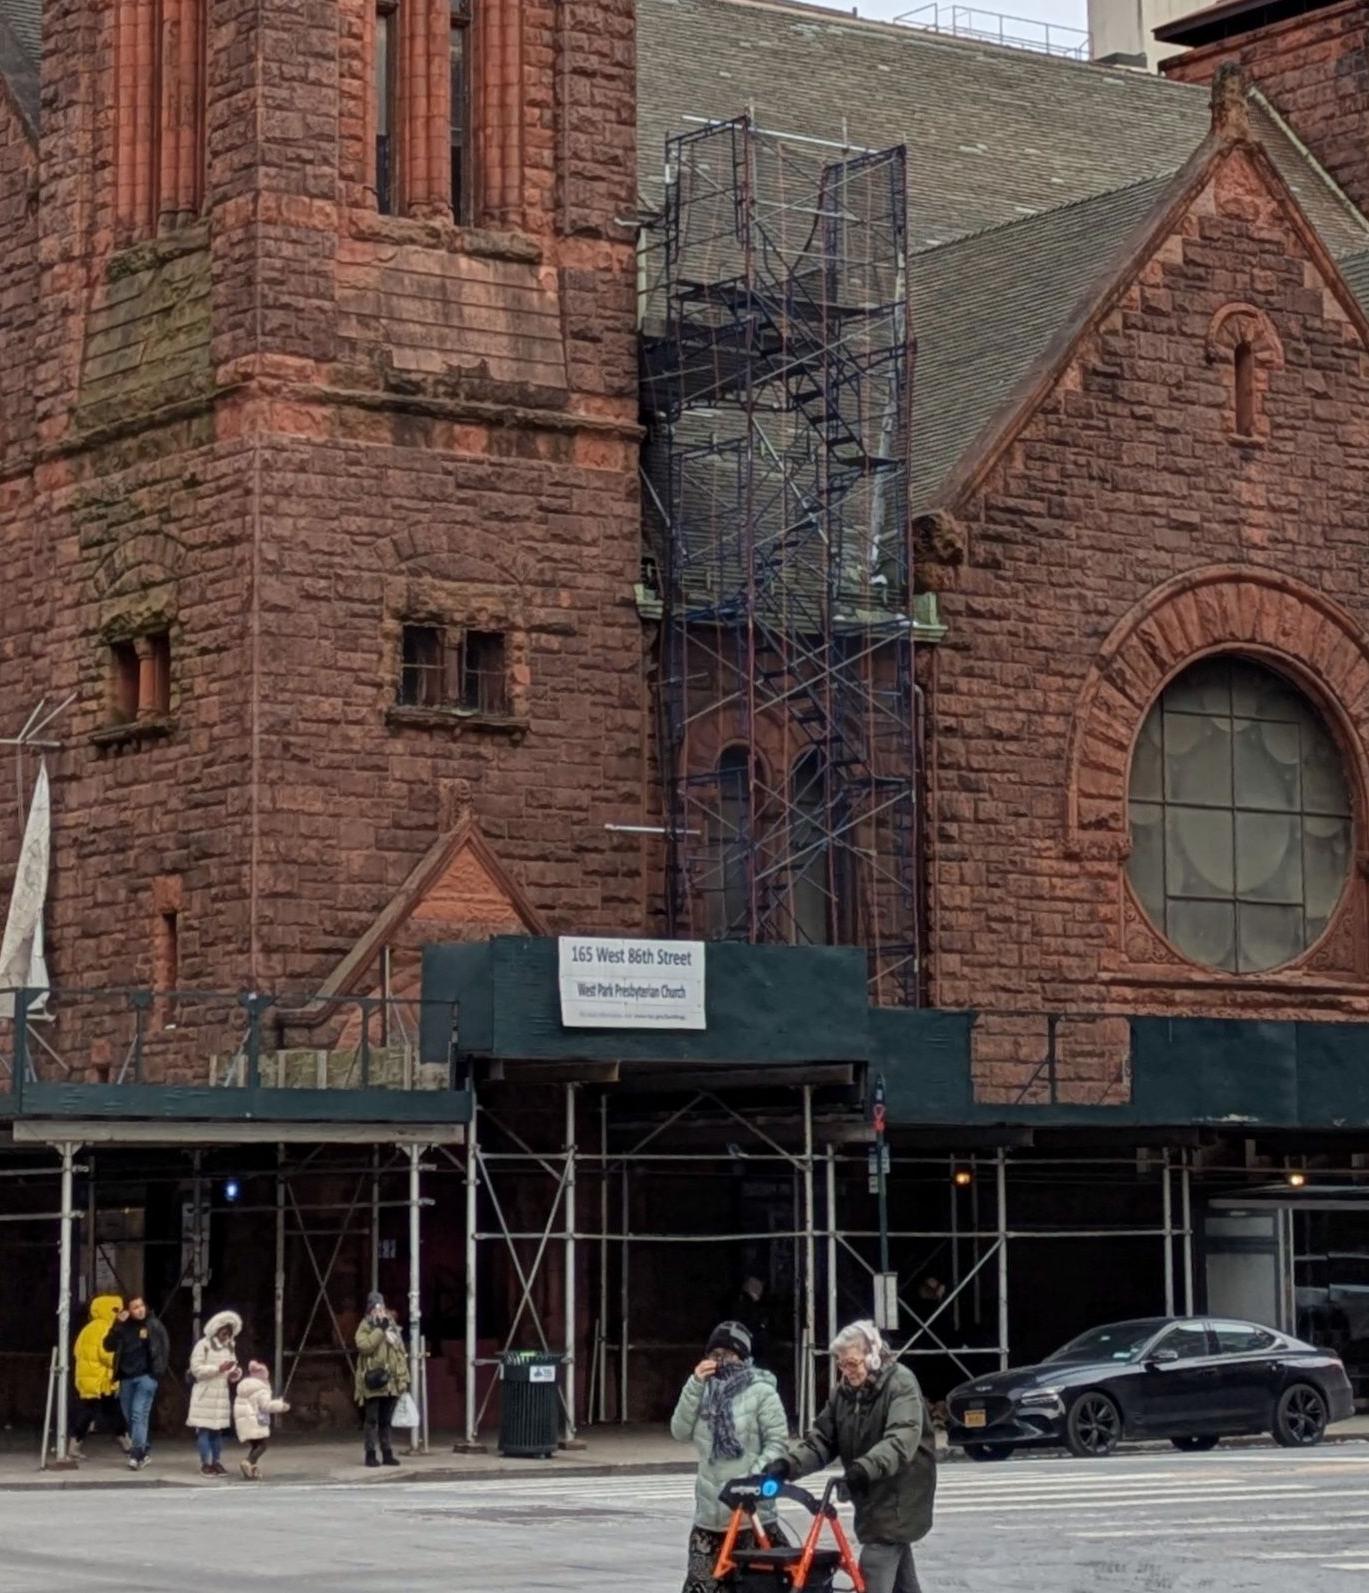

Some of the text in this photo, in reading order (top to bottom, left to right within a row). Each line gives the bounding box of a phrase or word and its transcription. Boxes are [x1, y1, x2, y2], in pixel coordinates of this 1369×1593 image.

[572, 946, 692, 966] 165 West 86th Street
[577, 983, 687, 1000] West Park Presbyterian Church
